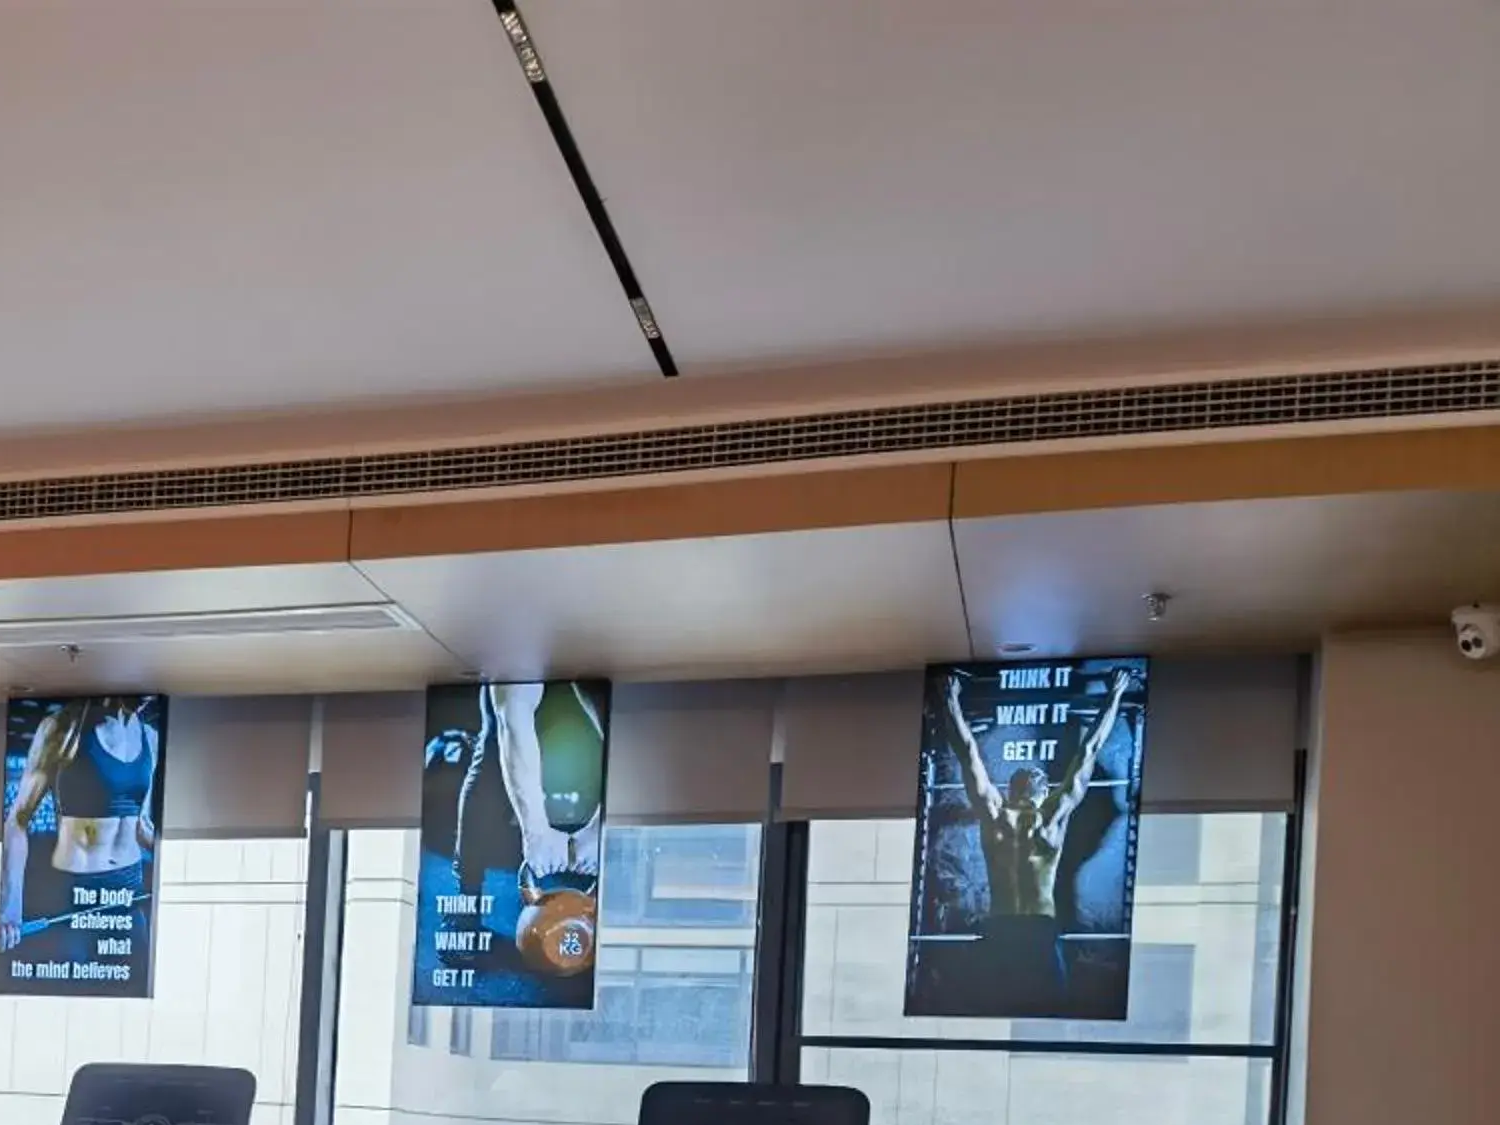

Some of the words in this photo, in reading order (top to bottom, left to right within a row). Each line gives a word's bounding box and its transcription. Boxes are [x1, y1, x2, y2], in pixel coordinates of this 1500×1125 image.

[999, 667, 1051, 689] THINK
[1055, 666, 1072, 687] IT
[996, 704, 1048, 725] WANT
[1051, 703, 1070, 724] IT
[1003, 740, 1036, 761] GET
[1040, 739, 1058, 761] IT
[73, 887, 97, 905] The
[100, 887, 134, 907] body
[436, 895, 477, 914] THINK
[480, 895, 494, 914] IT
[71, 912, 132, 930] achieves
[97, 937, 132, 955] what
[434, 931, 477, 951] WANT
[479, 931, 492, 951] IT
[11, 960, 33, 977] the
[36, 960, 70, 979] mind
[73, 961, 131, 981] believes
[432, 969, 458, 987] GET
[461, 969, 475, 987] IT
